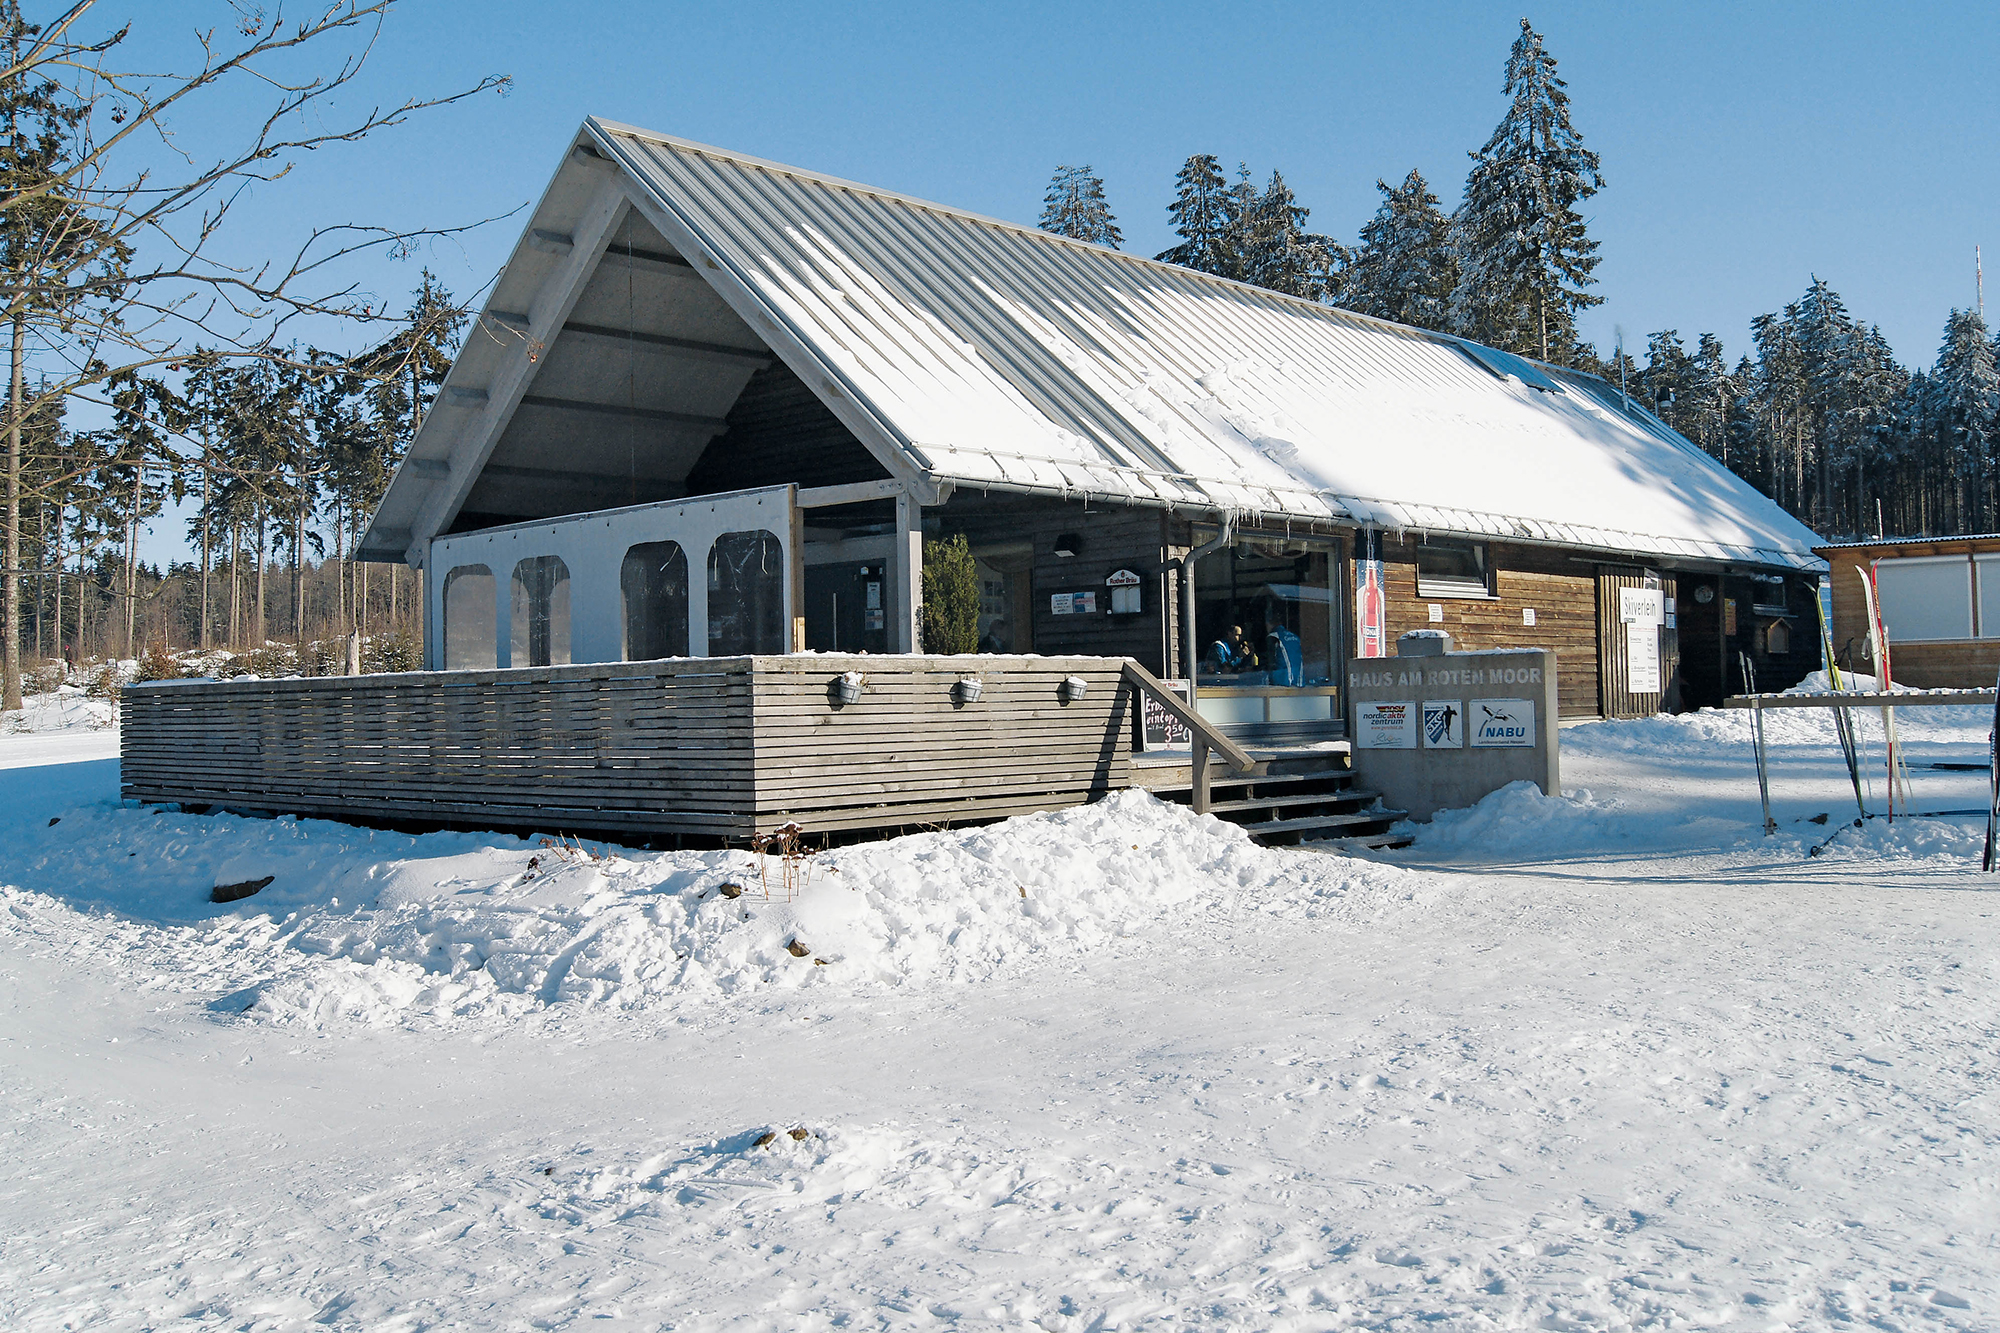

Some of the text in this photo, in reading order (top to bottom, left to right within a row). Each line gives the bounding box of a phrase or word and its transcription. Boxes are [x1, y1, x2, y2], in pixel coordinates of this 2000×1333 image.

[1624, 596, 1657, 616] Skiverleih
[1349, 667, 1541, 688] HAUS AM ROTEN MOOR
[1486, 727, 1525, 737] NABU
